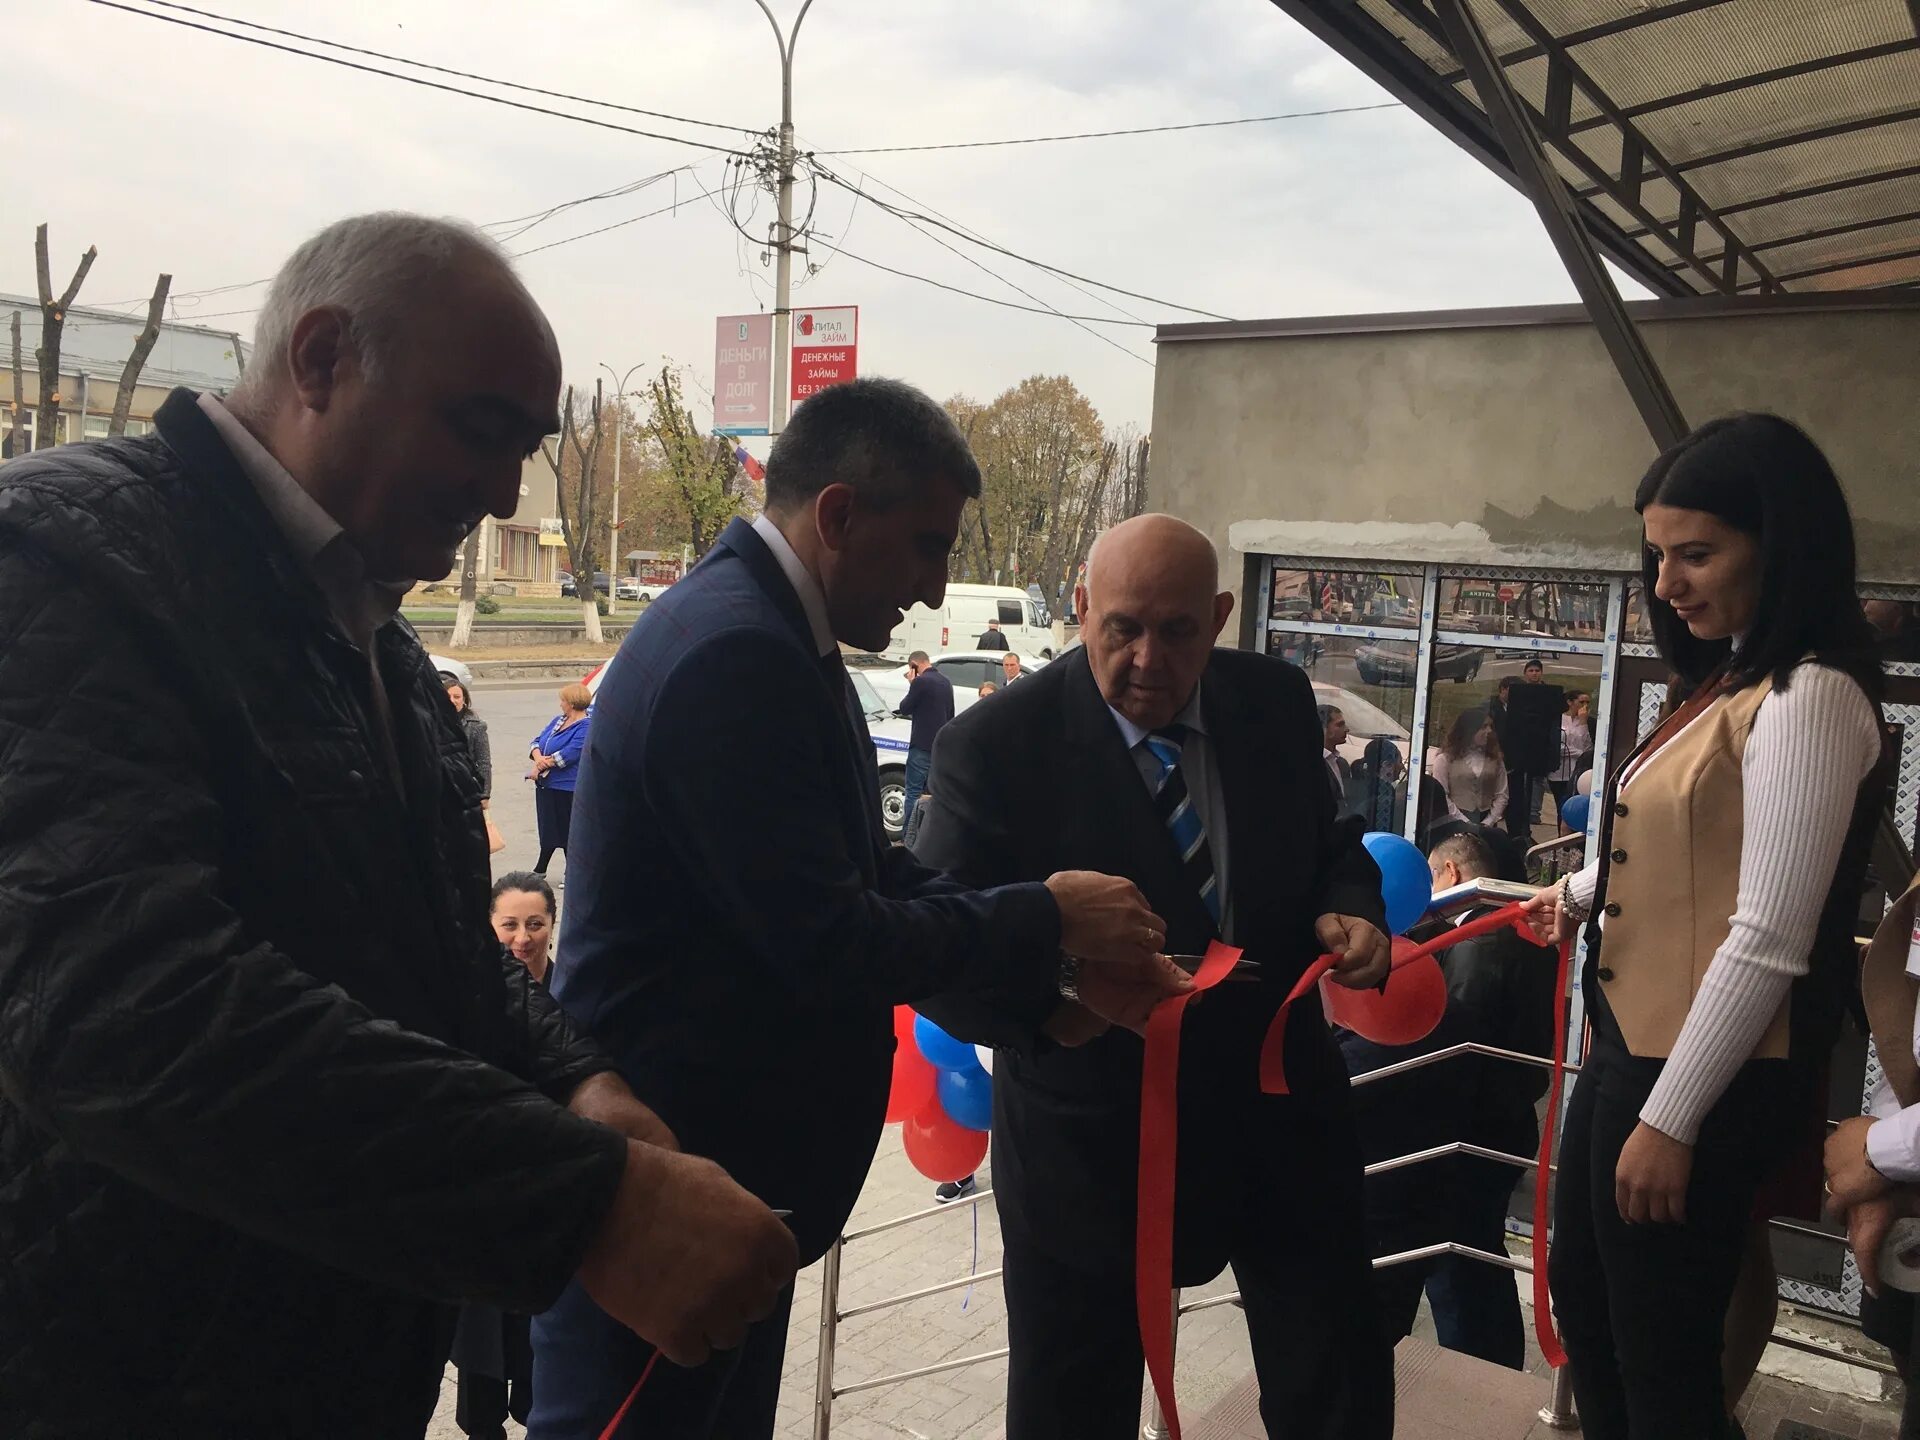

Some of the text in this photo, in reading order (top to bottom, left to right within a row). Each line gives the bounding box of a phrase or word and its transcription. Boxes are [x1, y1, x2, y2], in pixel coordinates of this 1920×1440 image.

[821, 332, 847, 343] ЗАЙМ
[719, 346, 767, 364] ДЕНЬГИ
[801, 352, 845, 364] ДЕНЕЖНЫЕ
[738, 365, 746, 379] В
[808, 367, 838, 379] ЗАЙМЫ
[726, 382, 758, 398] ДОЛГ
[797, 384, 812, 394] БЕЗ
